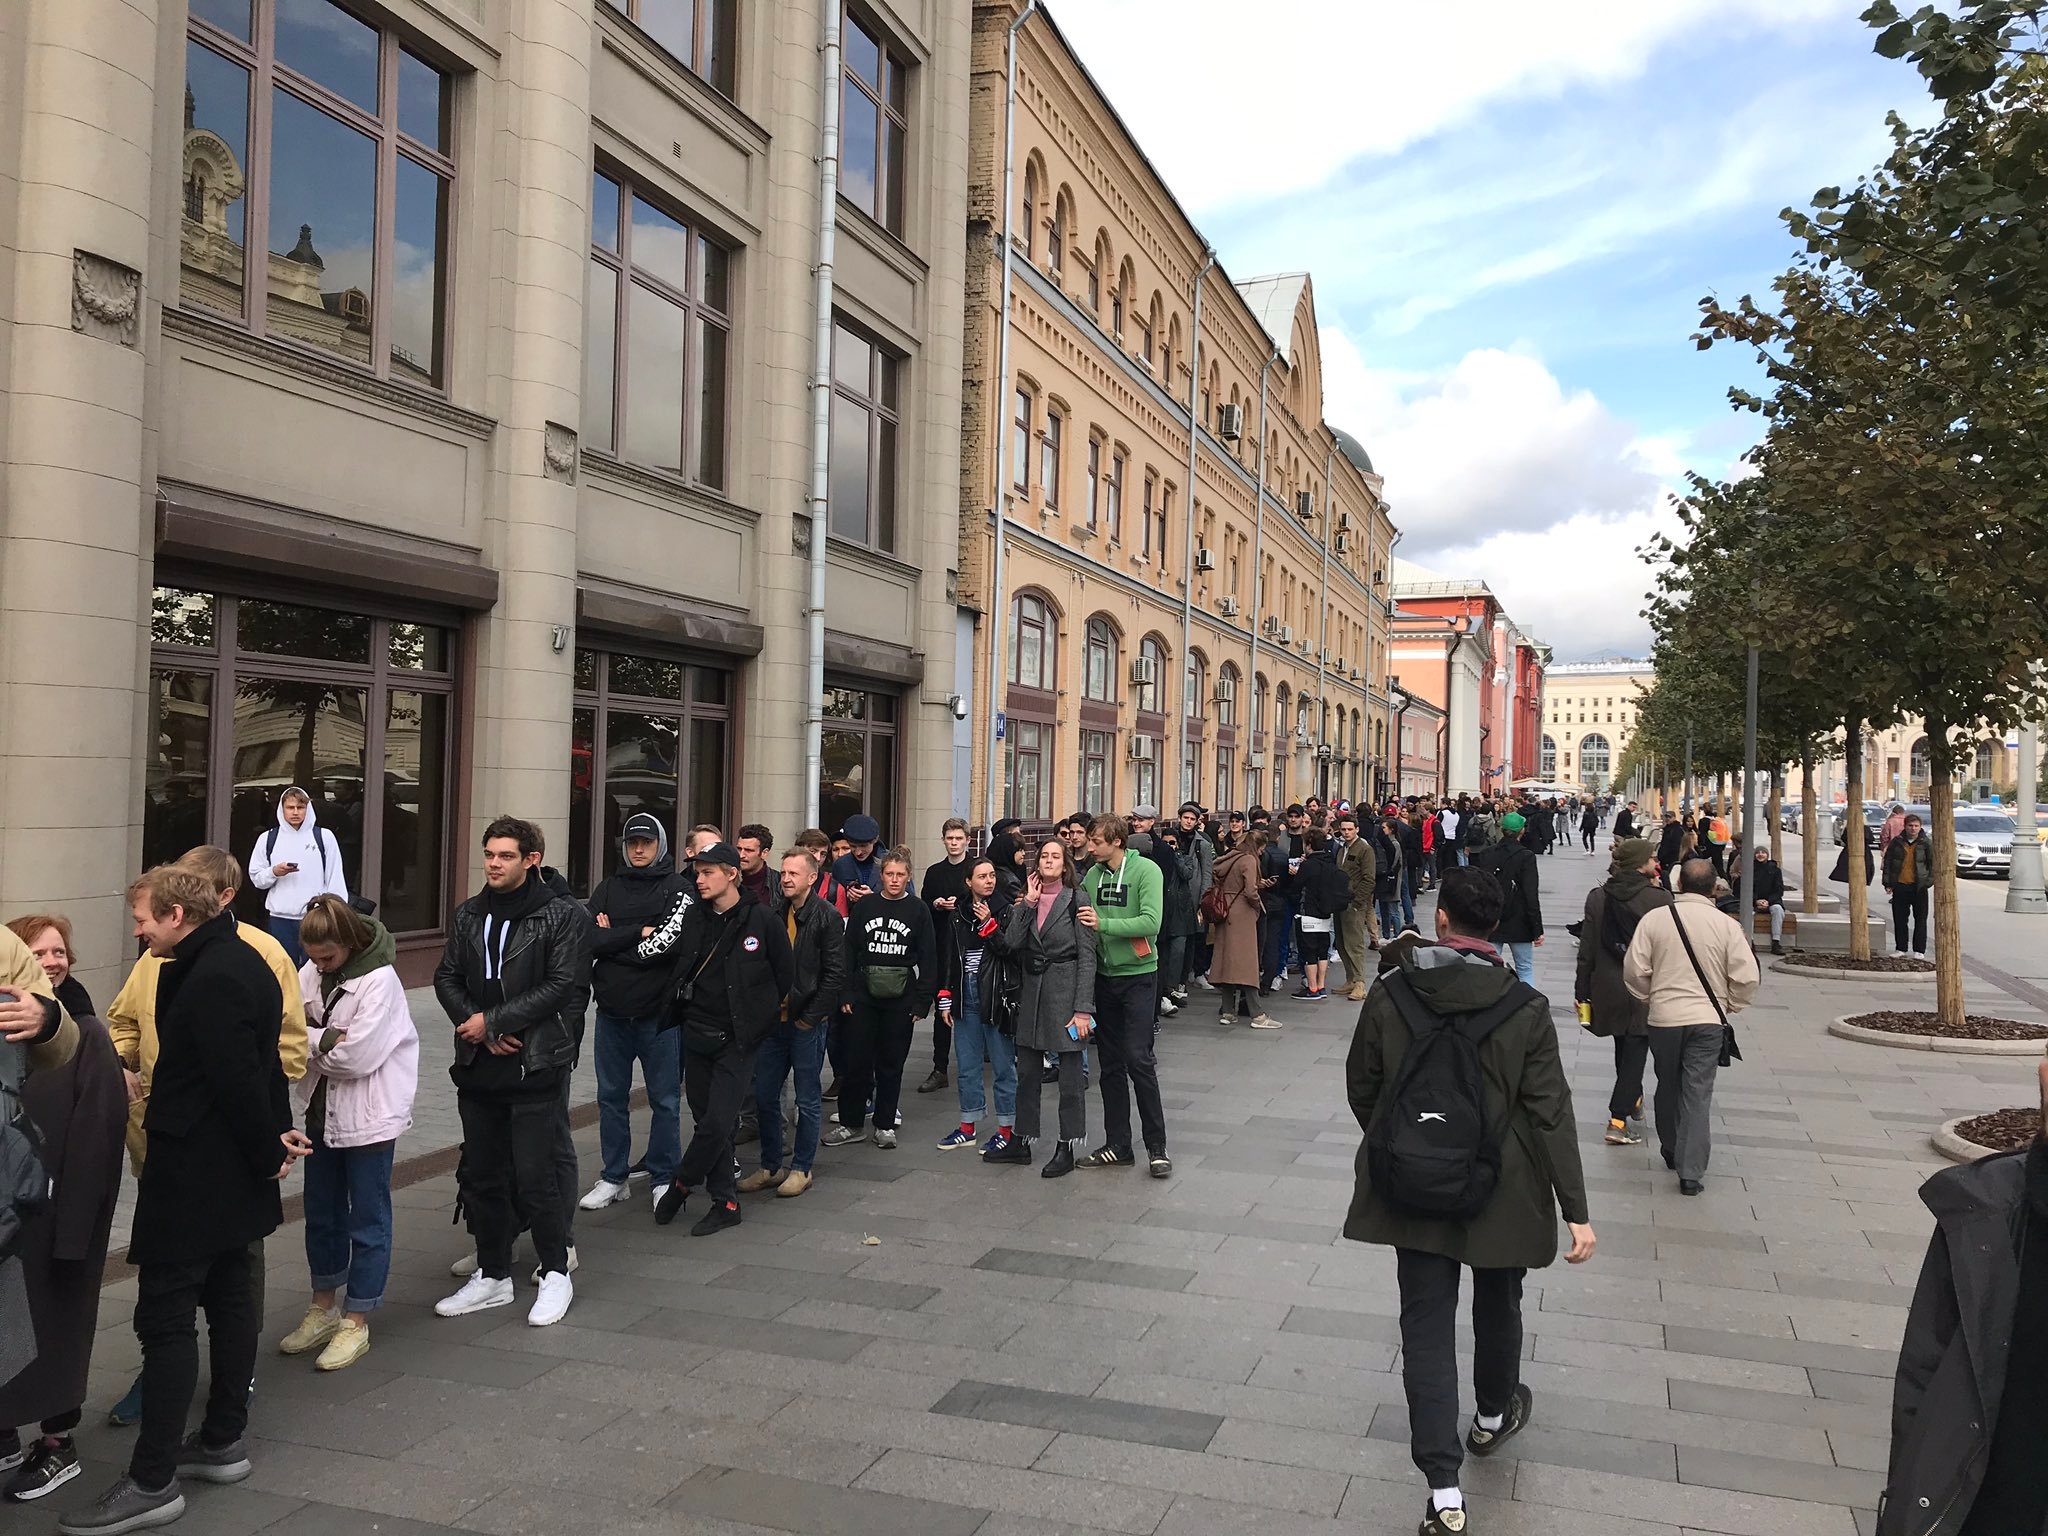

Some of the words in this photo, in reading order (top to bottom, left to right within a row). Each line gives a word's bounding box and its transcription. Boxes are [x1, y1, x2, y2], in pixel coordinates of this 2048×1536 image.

[997, 719, 1004, 732] 14
[864, 916, 884, 933] NEW
[874, 930, 898, 943] FILM
[867, 941, 908, 956] CADEMY
